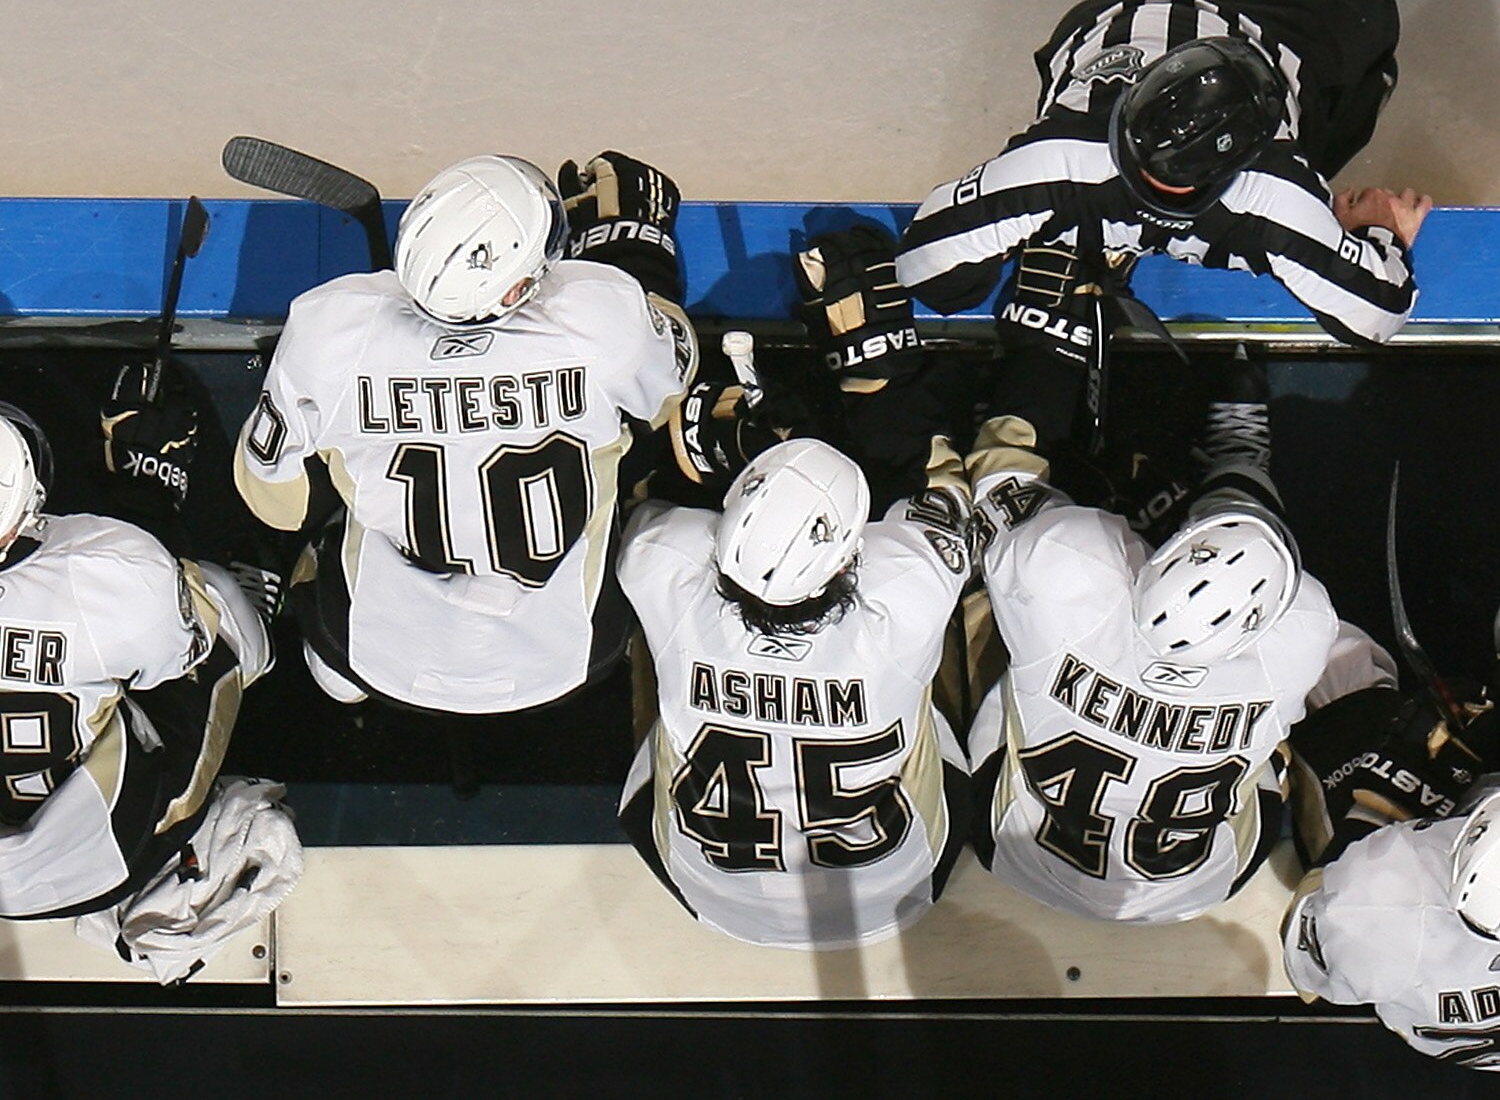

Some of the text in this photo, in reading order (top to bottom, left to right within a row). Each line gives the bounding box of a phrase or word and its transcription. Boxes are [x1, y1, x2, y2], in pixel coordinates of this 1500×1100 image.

[357, 366, 588, 433] LETESTU
[385, 429, 597, 589] 10
[691, 662, 868, 727] ASHAM
[1050, 653, 1275, 755] KENNEDY
[669, 719, 914, 873] 45
[1018, 730, 1251, 881] 48
